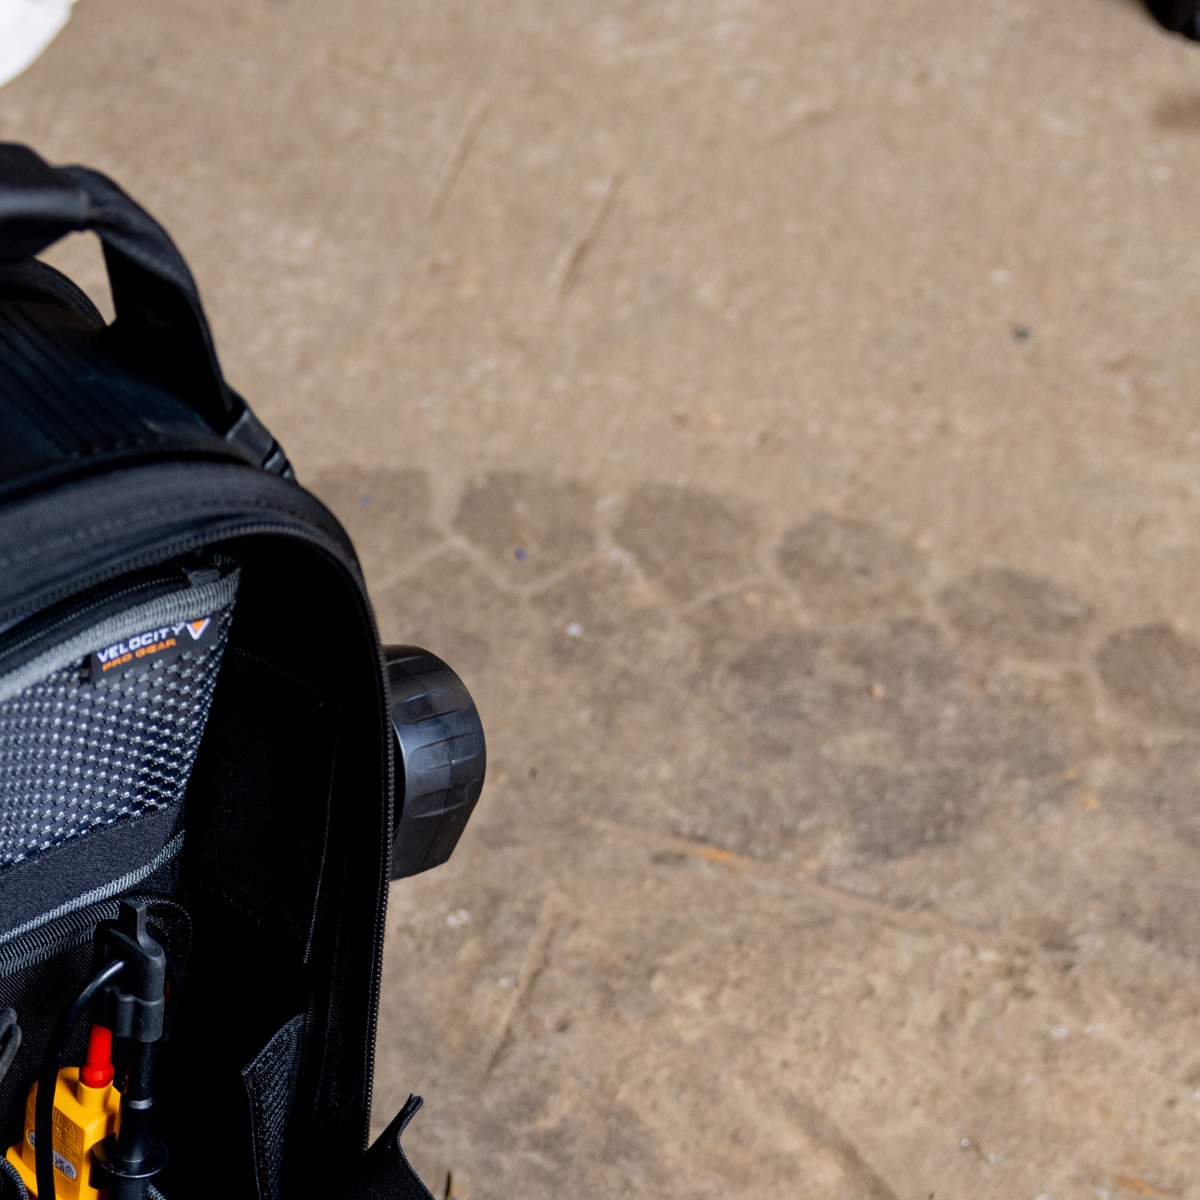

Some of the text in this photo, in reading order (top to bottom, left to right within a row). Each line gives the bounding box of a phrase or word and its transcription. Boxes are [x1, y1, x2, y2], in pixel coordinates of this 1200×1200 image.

[97, 621, 185, 662] VELOCITY
[102, 638, 177, 672] PRO GEAR
